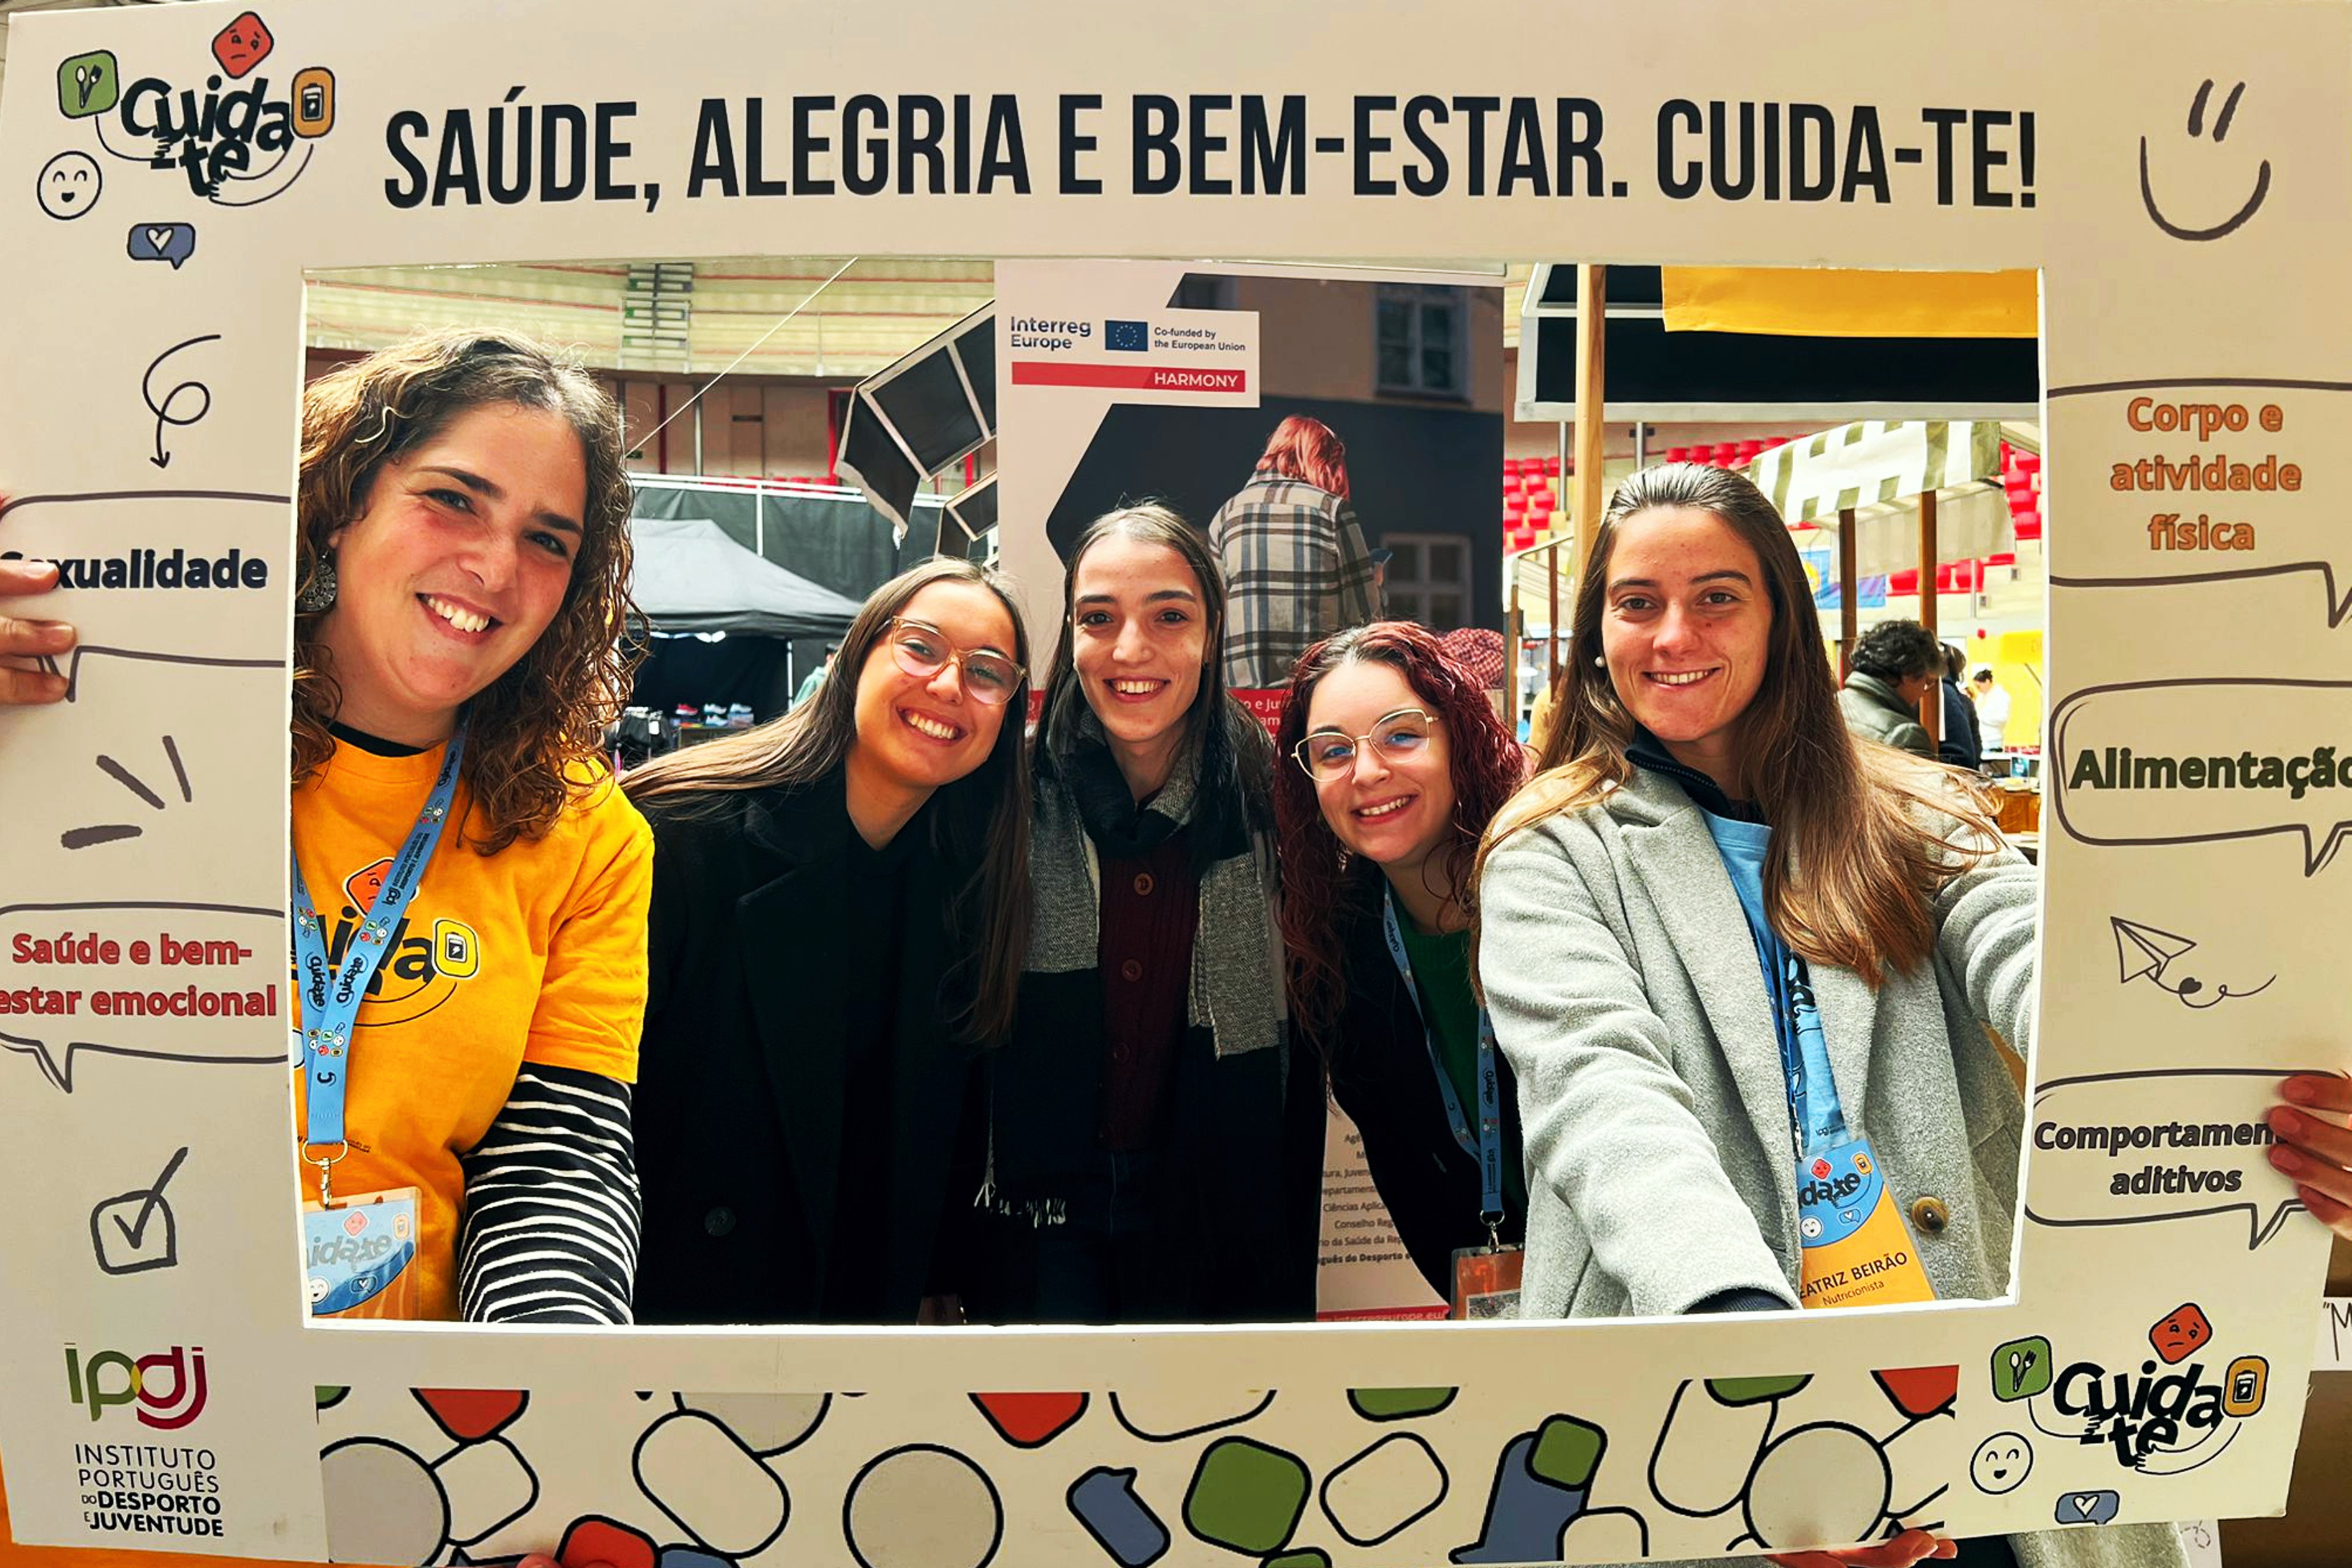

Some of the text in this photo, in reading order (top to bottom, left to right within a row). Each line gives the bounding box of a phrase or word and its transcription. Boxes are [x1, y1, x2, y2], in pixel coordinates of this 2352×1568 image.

[121, 75, 294, 152] Cuida
[385, 86, 2036, 213] SAÚDE, ALEGRIA E BEM-ESTAR. CUIDA-TE!
[1011, 317, 1091, 337] Interreg
[1154, 327, 1216, 340] Co-funded by
[1011, 334, 1072, 351] Europe
[1154, 340, 1246, 351] the European Union
[1154, 372, 1238, 387] HARMONY
[2127, 396, 2284, 442] Corpo e
[2110, 455, 2302, 491] atividade
[2148, 513, 2256, 551] física
[0, 549, 268, 589] xualidade
[12, 932, 253, 965] Saúde e bem-
[90, 984, 277, 1016] emocional
[2035, 1121, 2288, 1157] Comportamen
[2110, 1165, 2242, 1195] aditivos
[1360, 1202, 1386, 1212] Aplica
[1334, 1219, 1375, 1229] Conselho
[1345, 1254, 1357, 1262] do
[1360, 1253, 1403, 1263] Desporto
[1799, 1252, 1907, 1299] EATRIZ BEIRÃO
[1822, 1281, 1885, 1305] Nutricionista
[64, 1342, 208, 1430] ipdj
[2053, 1360, 2224, 1429] Cuida
[75, 1444, 215, 1470] INSTITUTO
[79, 1469, 218, 1493] PORTUGUÊS
[82, 1491, 221, 1515] DO DESPORTO
[84, 1511, 224, 1536] E JUVENTUDE
